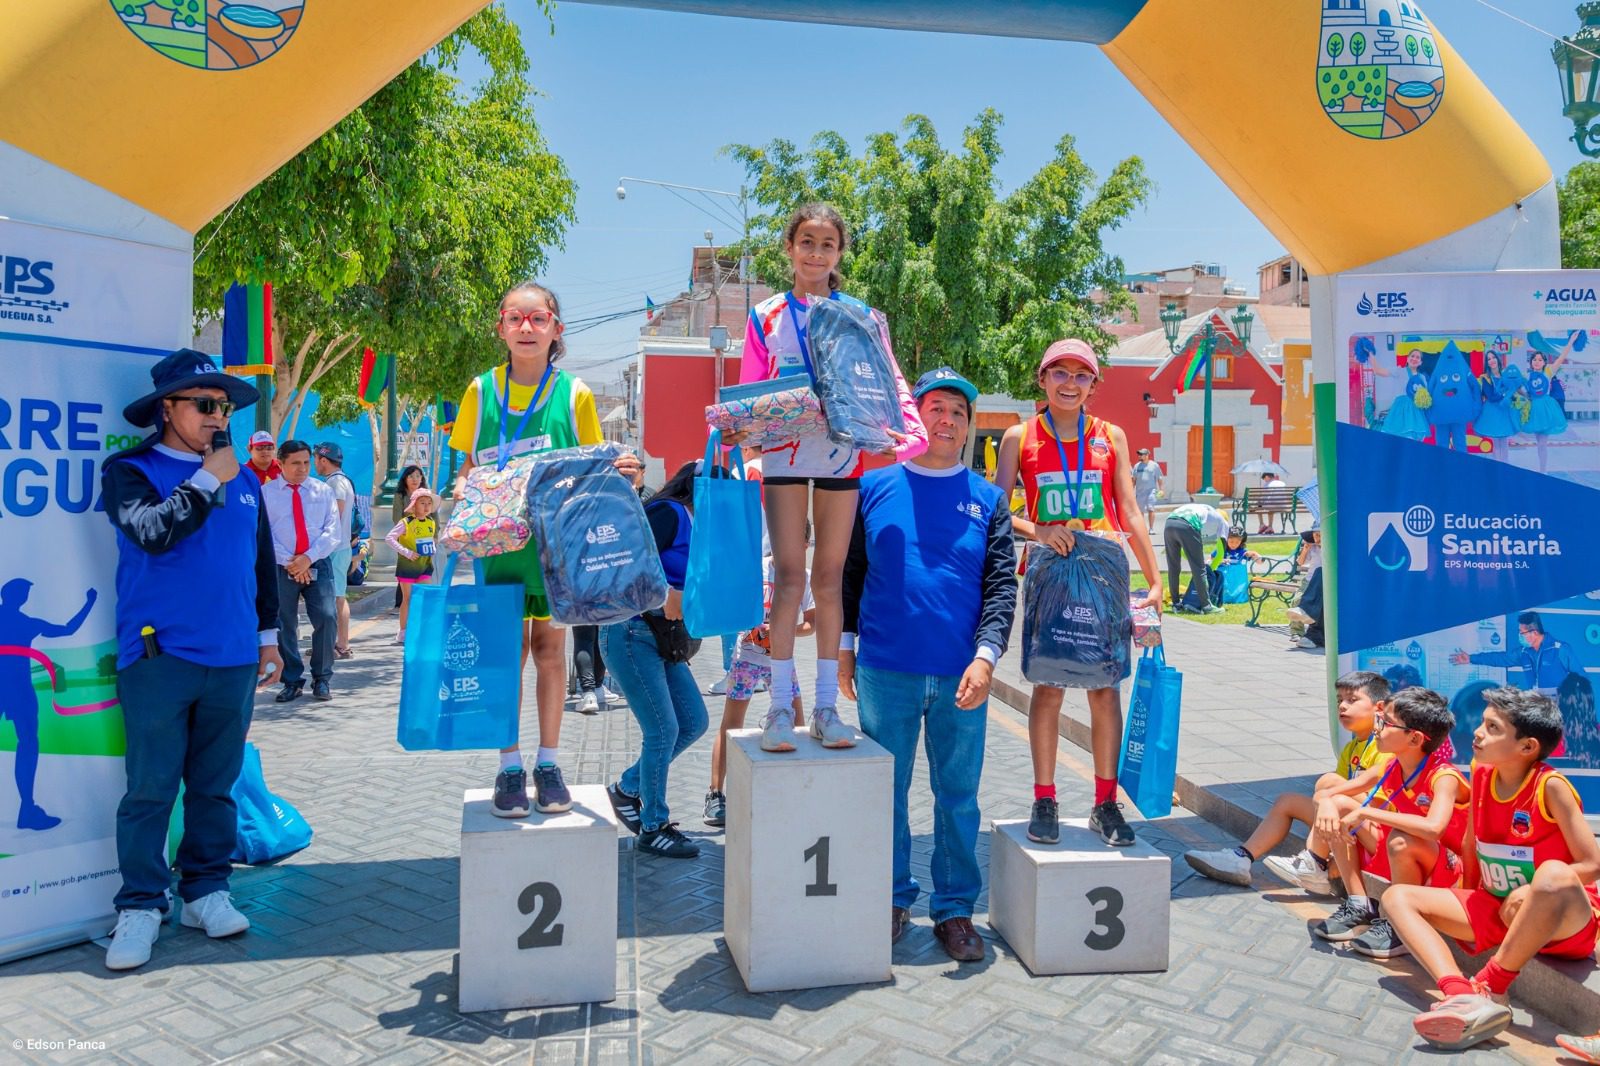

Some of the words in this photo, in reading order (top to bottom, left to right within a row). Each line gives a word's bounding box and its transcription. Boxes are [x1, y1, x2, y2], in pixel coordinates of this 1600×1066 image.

[0, 254, 55, 295] PS
[1377, 292, 1408, 308] EPS
[1546, 288, 1597, 301] AGUA
[0, 458, 106, 517] GU
[1046, 487, 1094, 516] 094
[596, 524, 616, 536] EPS
[1443, 513, 1542, 530] Educación
[1441, 533, 1562, 556] Sanitaria
[1444, 560, 1462, 569] EPS
[1463, 560, 1513, 571] Moquegua
[1514, 560, 1530, 569] S.A.
[1074, 606, 1092, 617] EPS
[444, 649, 474, 660] Agua
[453, 676, 479, 692] EPS
[804, 836, 838, 896] 1
[517, 882, 563, 949] 2
[1084, 886, 1126, 951] 3
